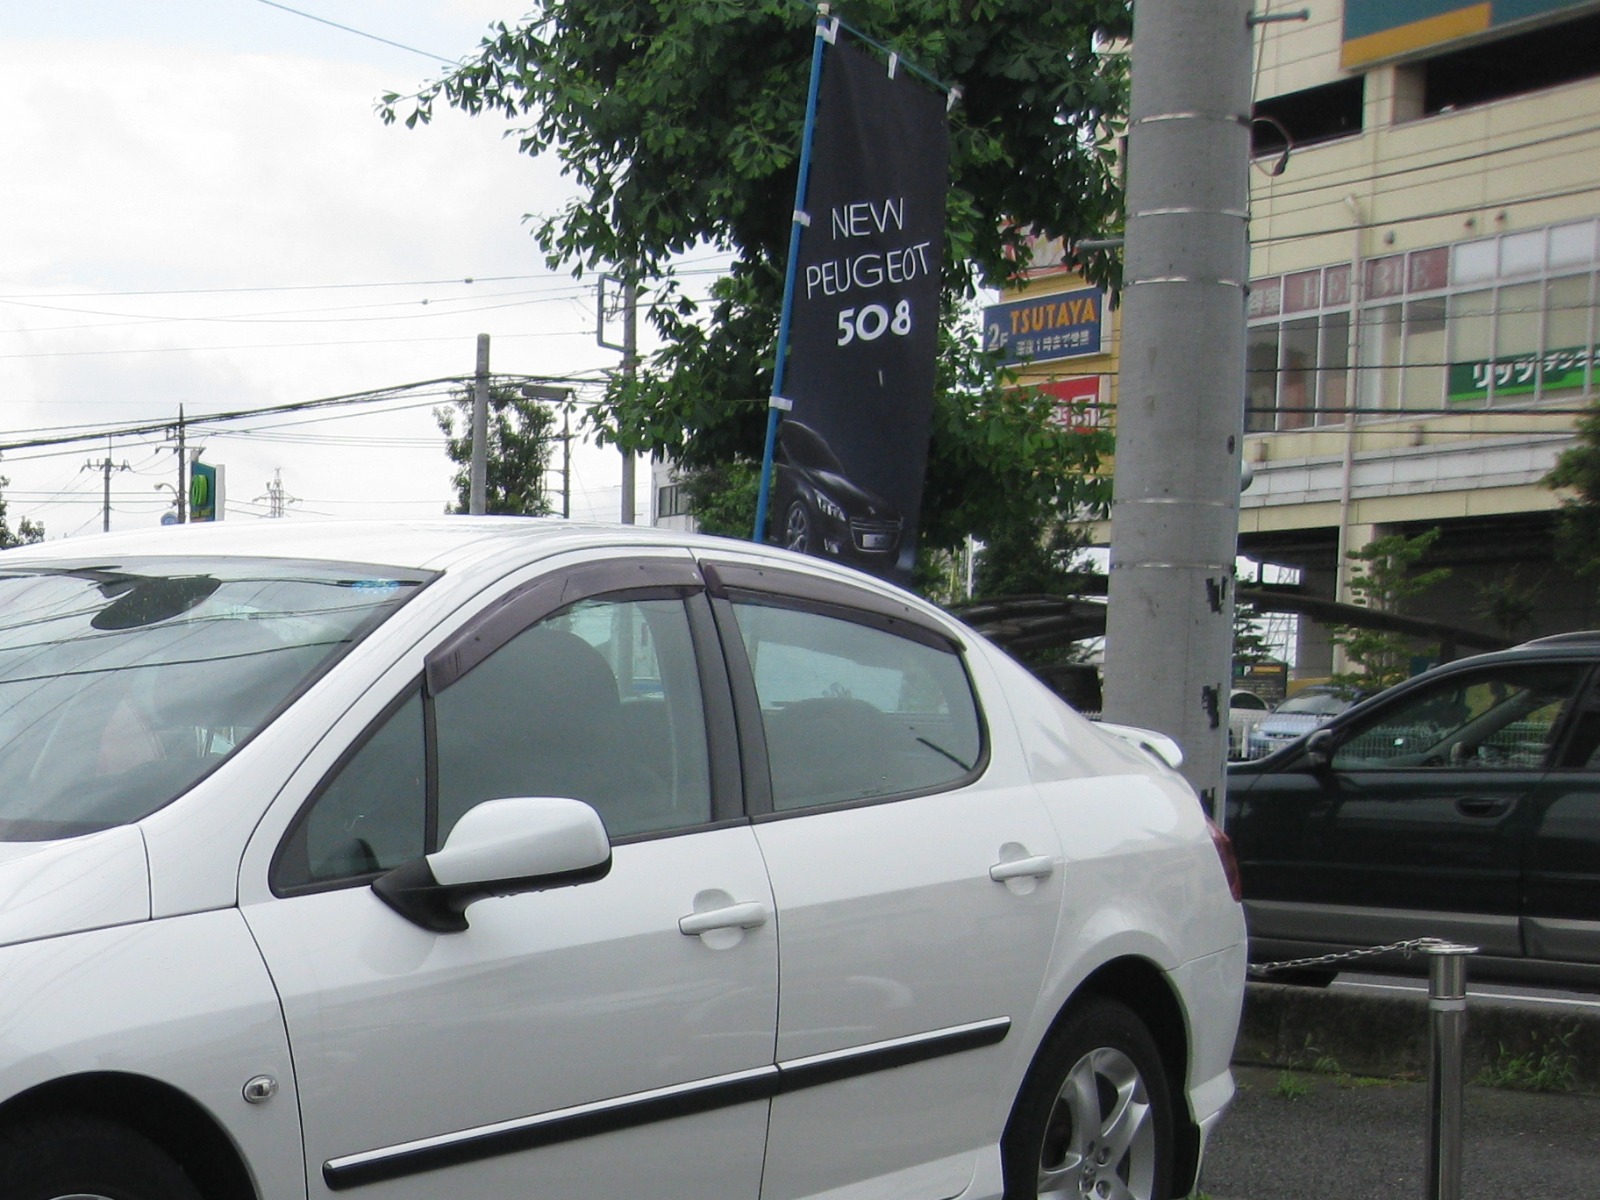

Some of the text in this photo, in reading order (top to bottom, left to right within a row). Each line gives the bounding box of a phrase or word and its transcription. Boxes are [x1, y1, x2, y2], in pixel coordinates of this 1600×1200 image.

[831, 197, 904, 241] NEW
[806, 241, 931, 300] PEUGEOT
[836, 299, 912, 346] 508
[1010, 298, 1097, 336] TSUTAYA
